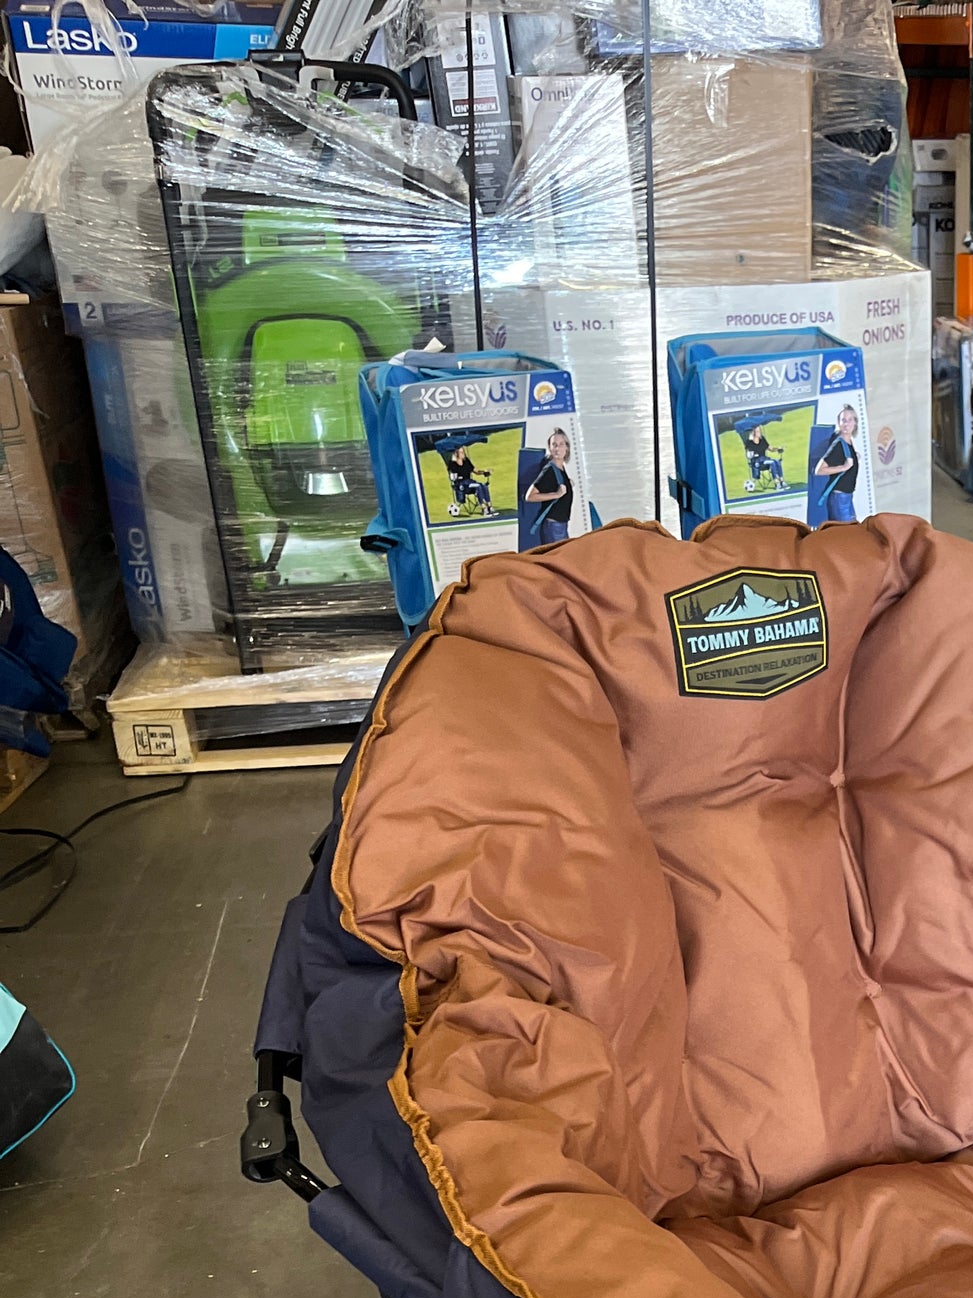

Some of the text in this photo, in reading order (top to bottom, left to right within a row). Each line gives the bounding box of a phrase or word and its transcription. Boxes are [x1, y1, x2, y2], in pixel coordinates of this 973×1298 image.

[294, 8, 310, 26] Full
[23, 21, 138, 52] Lasko
[284, 20, 302, 50] Brigh
[454, 104, 497, 114] KIRKAND
[726, 311, 835, 326] PRODUCE OF USA
[866, 299, 900, 319] FRESH
[552, 320, 577, 331] U.S.
[582, 320, 606, 331] NO.
[862, 324, 905, 346] ONIONS
[422, 411, 442, 423] BUILT
[442, 411, 460, 421] FOR
[460, 410, 474, 419] LIFE
[473, 406, 519, 418] OUTDOORS
[687, 618, 819, 654] TOMMY BAHAMA
[696, 653, 818, 682] DESTINATION RELAXATION
[155, 741, 167, 749] HT
